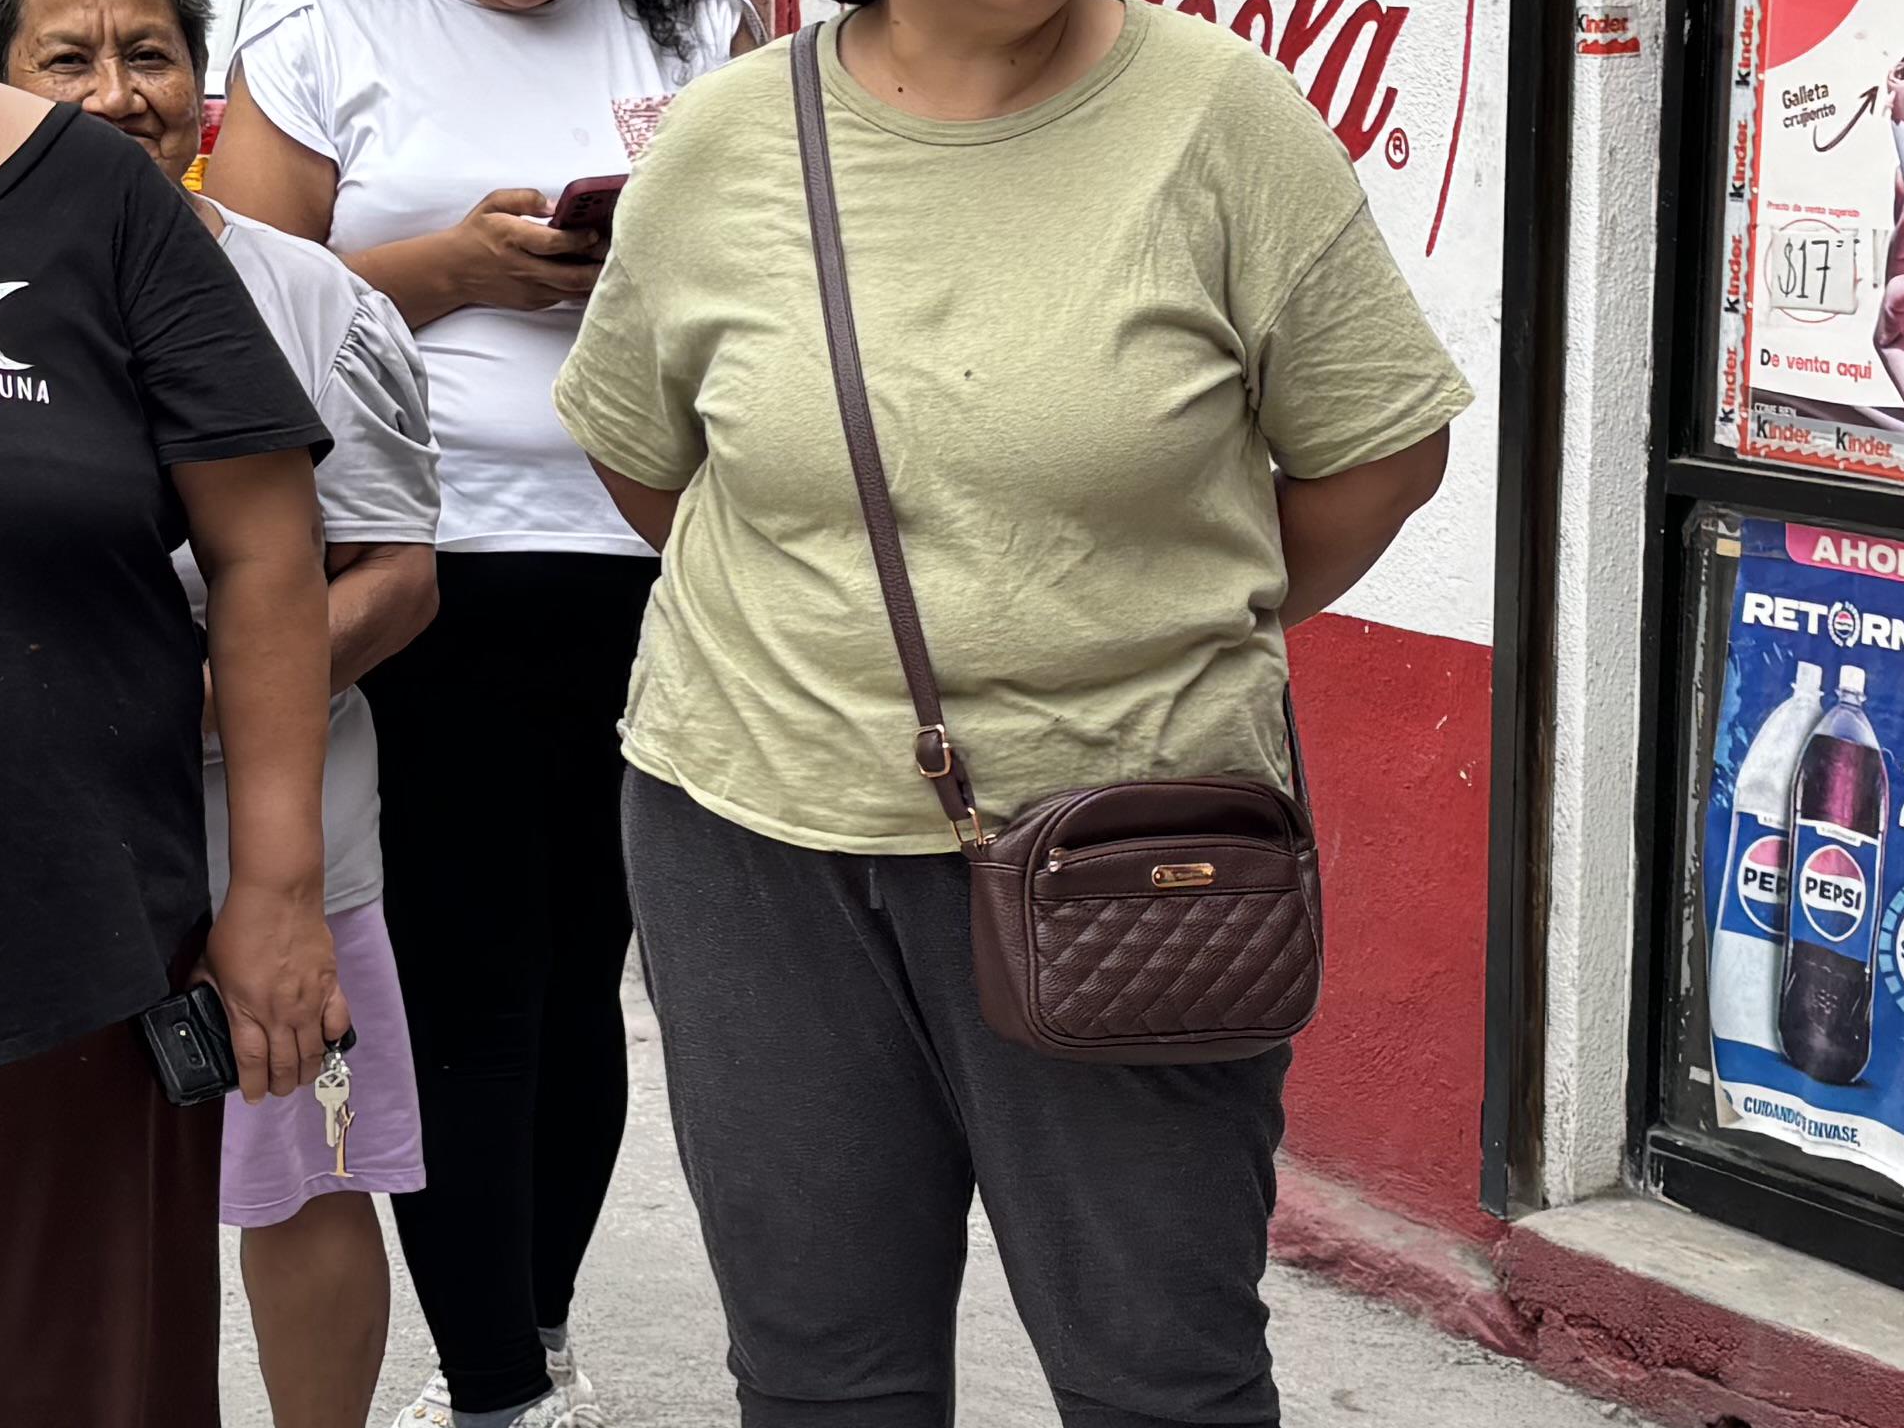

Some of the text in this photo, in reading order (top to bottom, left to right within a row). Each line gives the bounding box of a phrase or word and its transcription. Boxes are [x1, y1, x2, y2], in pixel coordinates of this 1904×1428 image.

[1782, 83, 1830, 110] Galleta
[1760, 348, 1781, 368] De
[1786, 355, 1830, 375] venta
[1805, 876, 1863, 912] PEPSI
